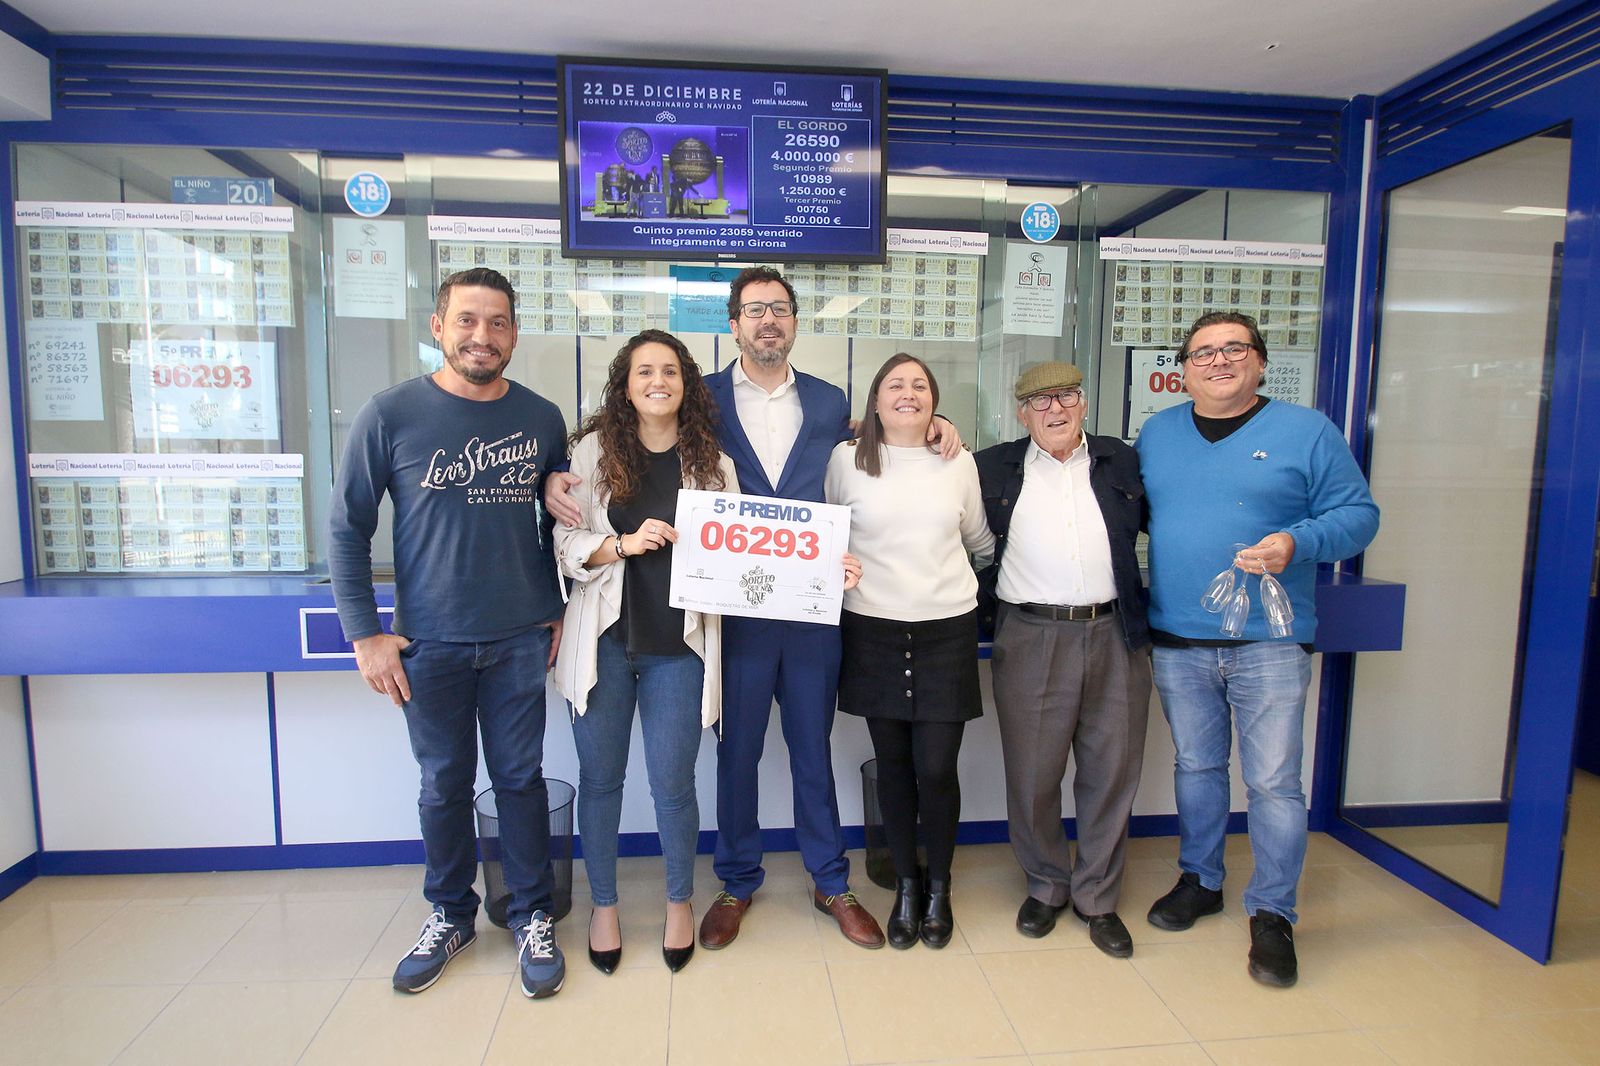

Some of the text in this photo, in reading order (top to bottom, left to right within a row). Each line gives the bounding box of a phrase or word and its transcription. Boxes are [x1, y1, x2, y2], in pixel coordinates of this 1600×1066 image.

[583, 82, 742, 100] 22 DE DICIEMBRE
[618, 100, 692, 109] EXTRAORDINARIO
[777, 100, 808, 108] NACIONAL
[777, 120, 848, 132] EL GORDO
[785, 133, 840, 148] 26590
[770, 150, 855, 163] 4.000.000 €
[772, 163, 853, 173] Segundo Premio
[174, 178, 211, 188] EL NIÑO
[793, 174, 833, 184] 10989
[229, 184, 258, 204] 20
[350, 182, 380, 201] +18
[779, 186, 847, 196] 1.250.000 €
[784, 196, 842, 205] Tercer Premio
[796, 205, 829, 214] 00750
[784, 215, 842, 225] 500.000 €
[1026, 212, 1051, 229] +18
[633, 226, 803, 238] Quinto premio 23059 vendido
[650, 237, 728, 248] integramente
[747, 239, 787, 248] Girona
[45, 341, 86, 350] 69241
[46, 353, 87, 361] 86372
[47, 364, 88, 372] 58563
[1268, 366, 1302, 375] 69241
[48, 375, 88, 384] 71697
[153, 364, 252, 388] 06293
[1268, 377, 1300, 385] 86372
[1267, 386, 1300, 394] 58563
[454, 431, 538, 487] Strauss
[500, 466, 516, 485] &
[468, 496, 532, 504] CALIFORNIA
[739, 500, 812, 522] PREMIO
[700, 520, 820, 561] 06293
[739, 574, 775, 588] SORTEO
[744, 590, 766, 606] UNE
